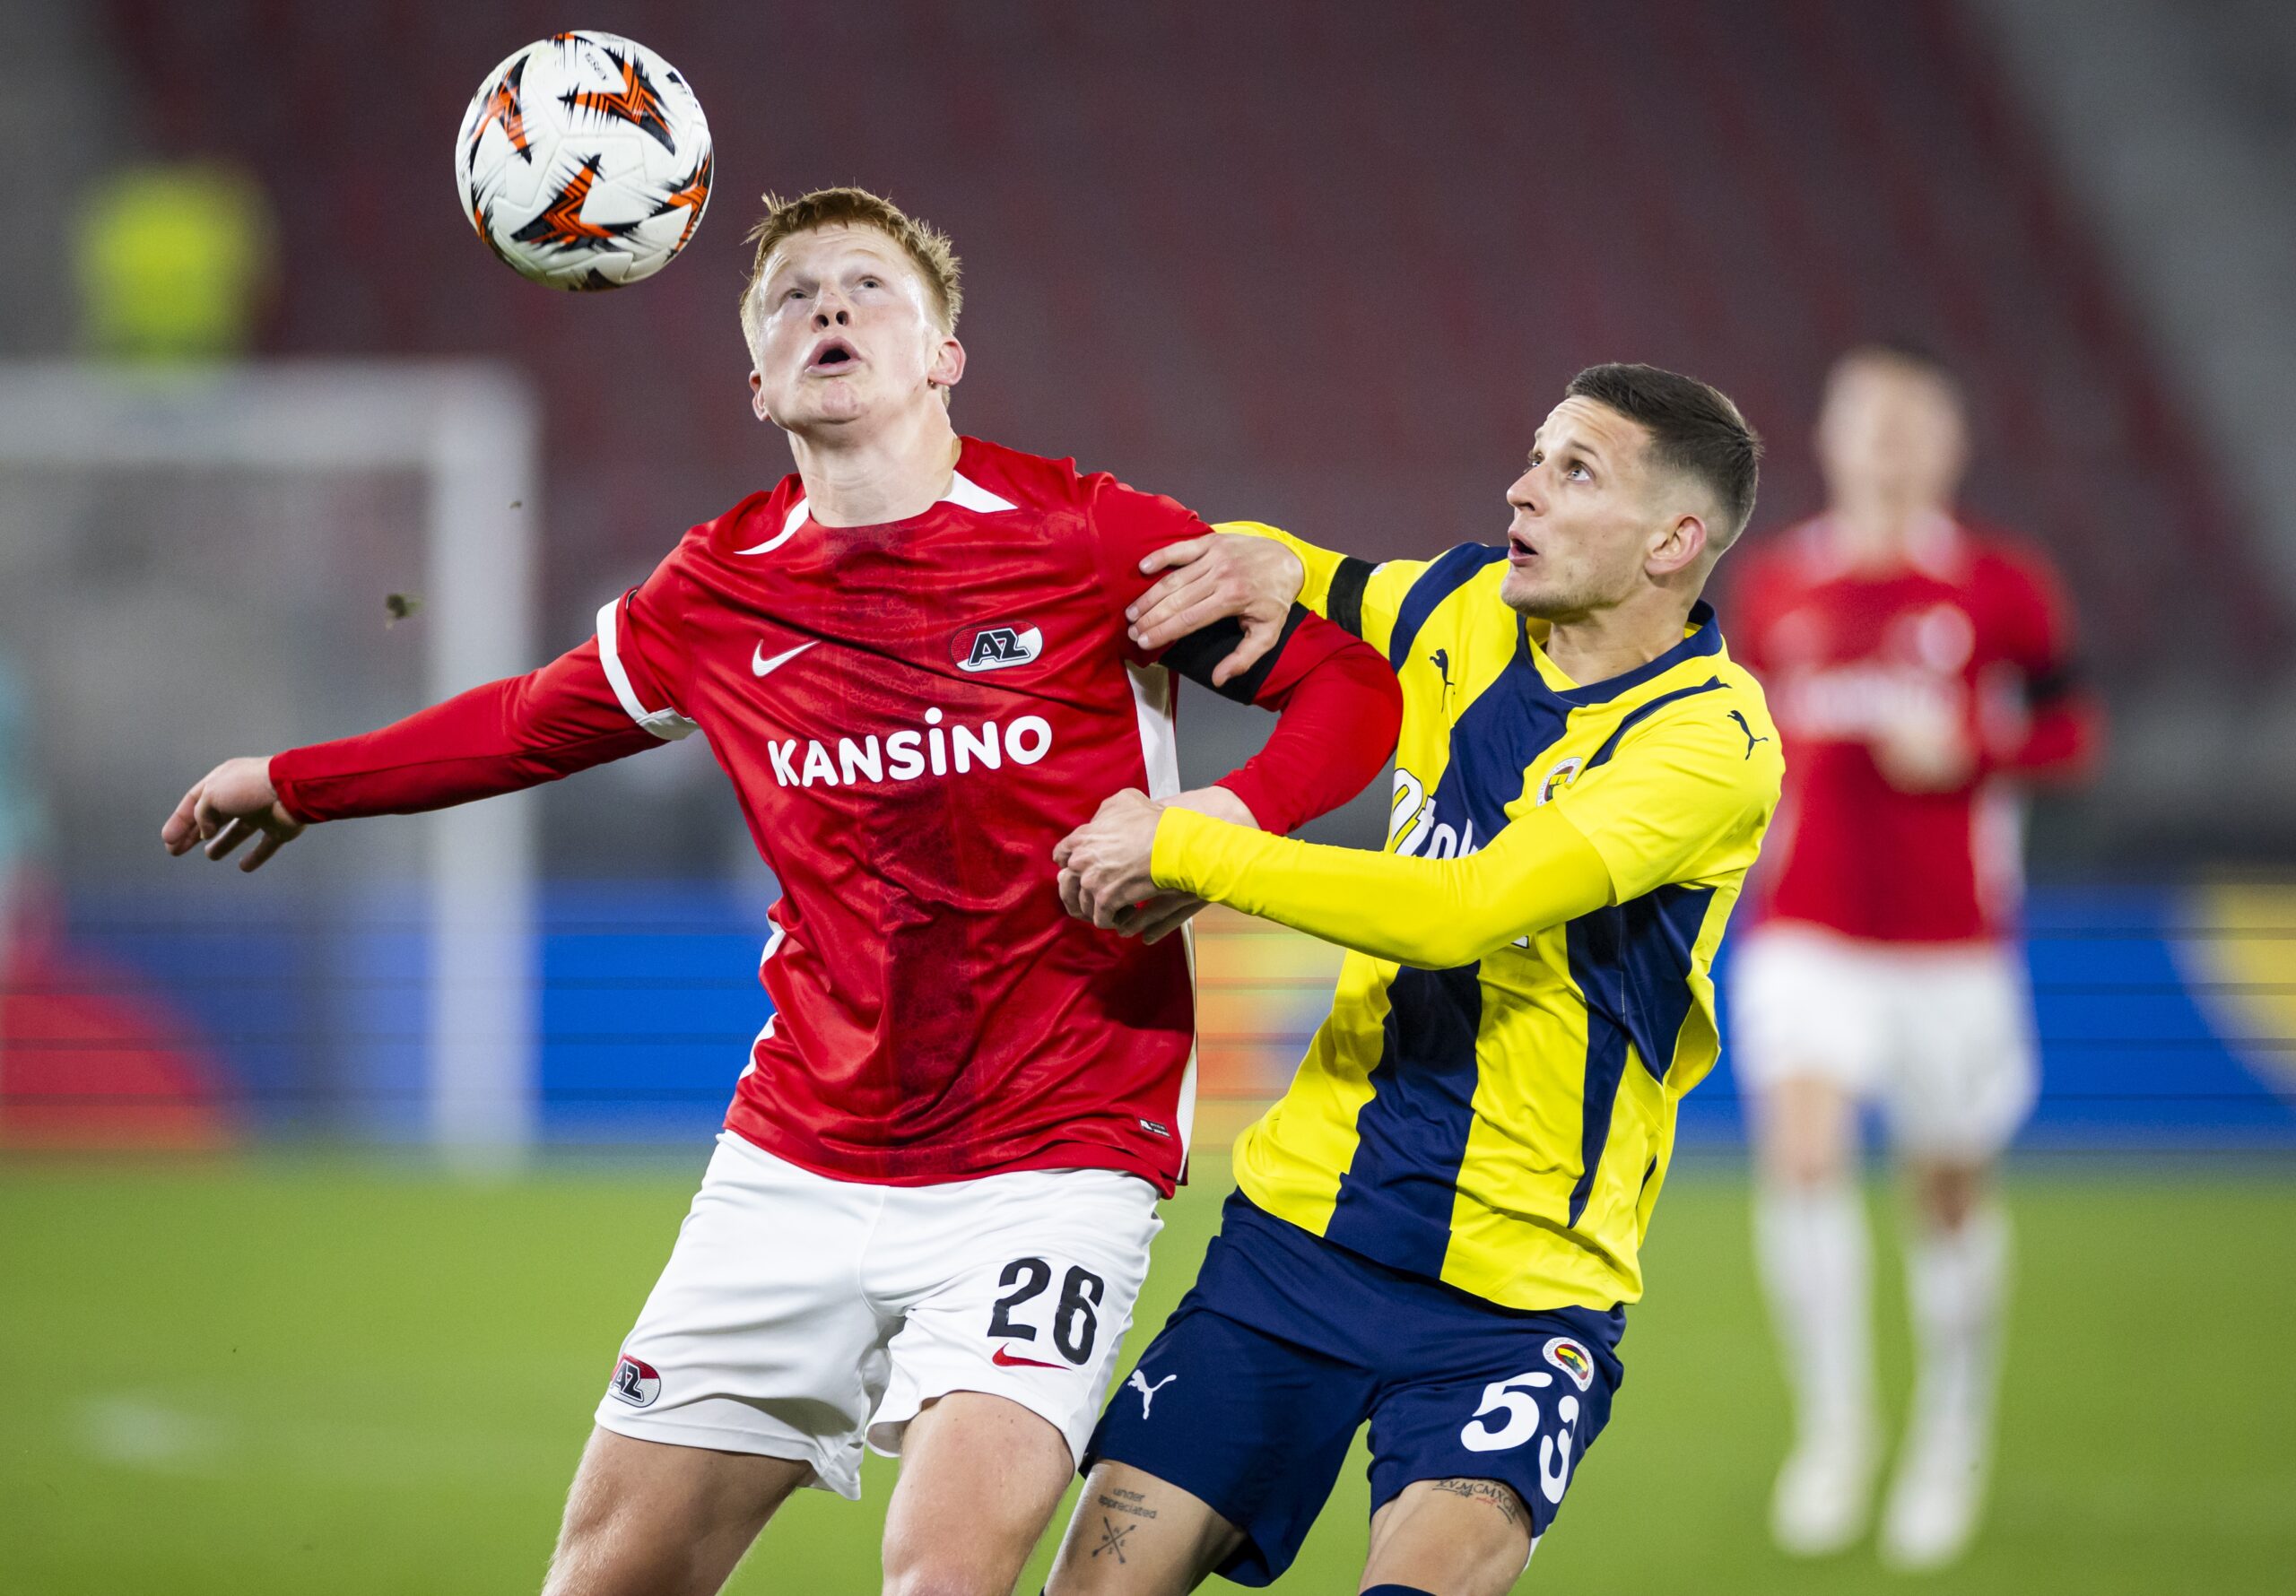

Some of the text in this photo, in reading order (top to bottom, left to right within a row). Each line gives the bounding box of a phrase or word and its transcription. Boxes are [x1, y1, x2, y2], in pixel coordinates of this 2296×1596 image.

[968, 628, 1031, 667] AZ
[987, 1256, 1105, 1366] 26
[610, 1358, 645, 1403] AZ
[1112, 1488, 1146, 1502] under
